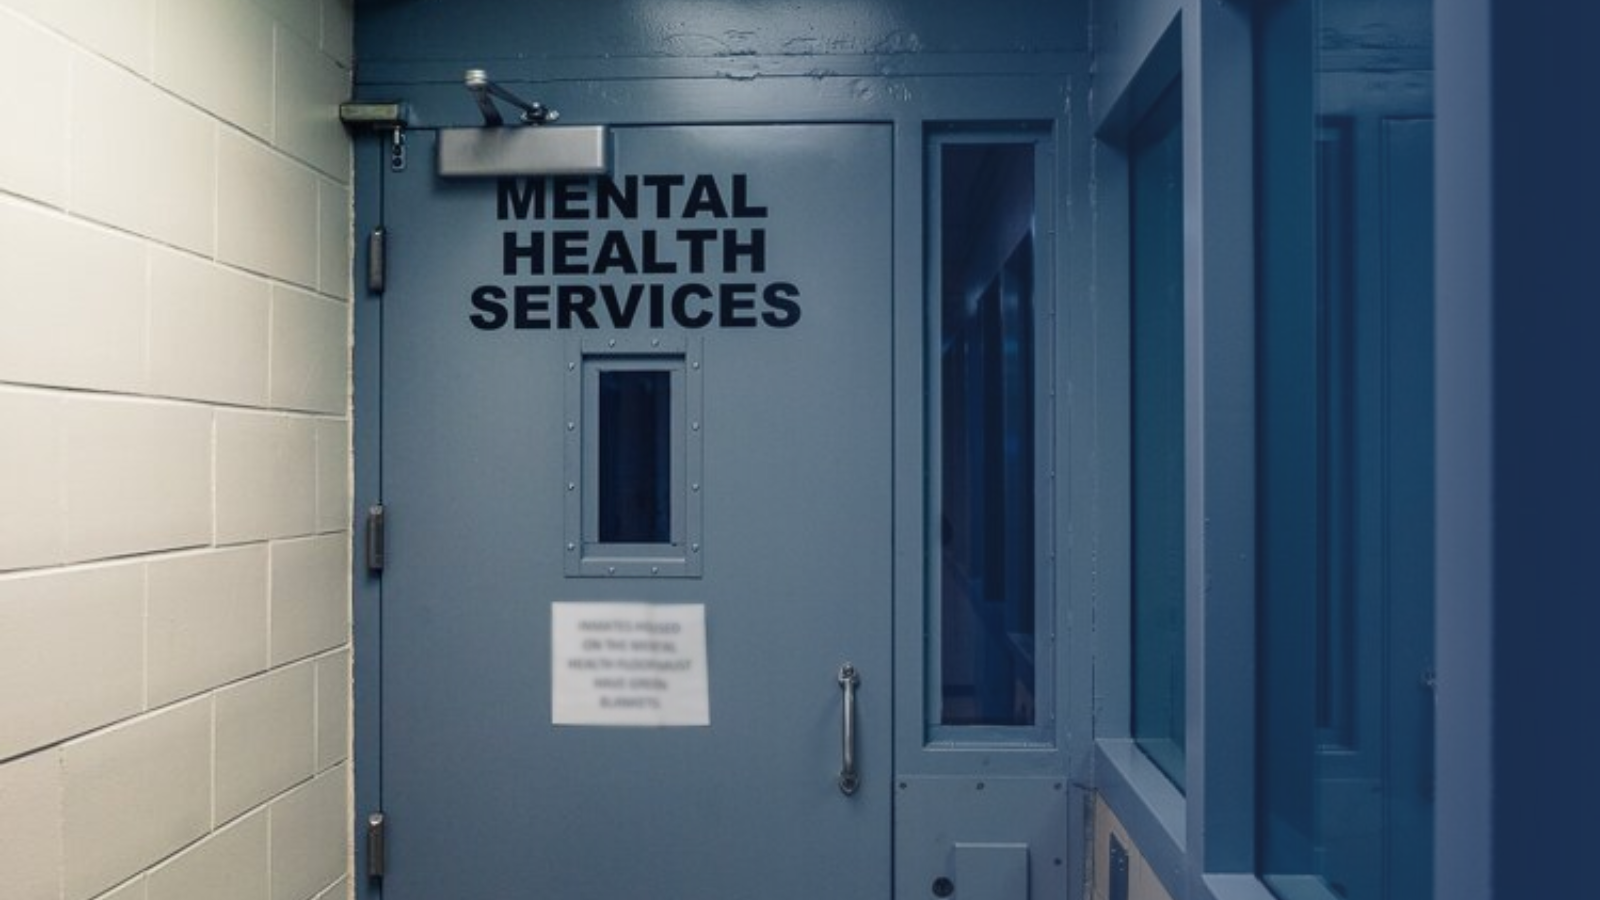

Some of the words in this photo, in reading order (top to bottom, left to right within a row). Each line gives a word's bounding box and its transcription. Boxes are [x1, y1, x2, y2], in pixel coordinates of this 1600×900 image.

[496, 174, 768, 220] MENTAL
[503, 229, 766, 275] HEALTH
[469, 282, 801, 330] SERVICES
